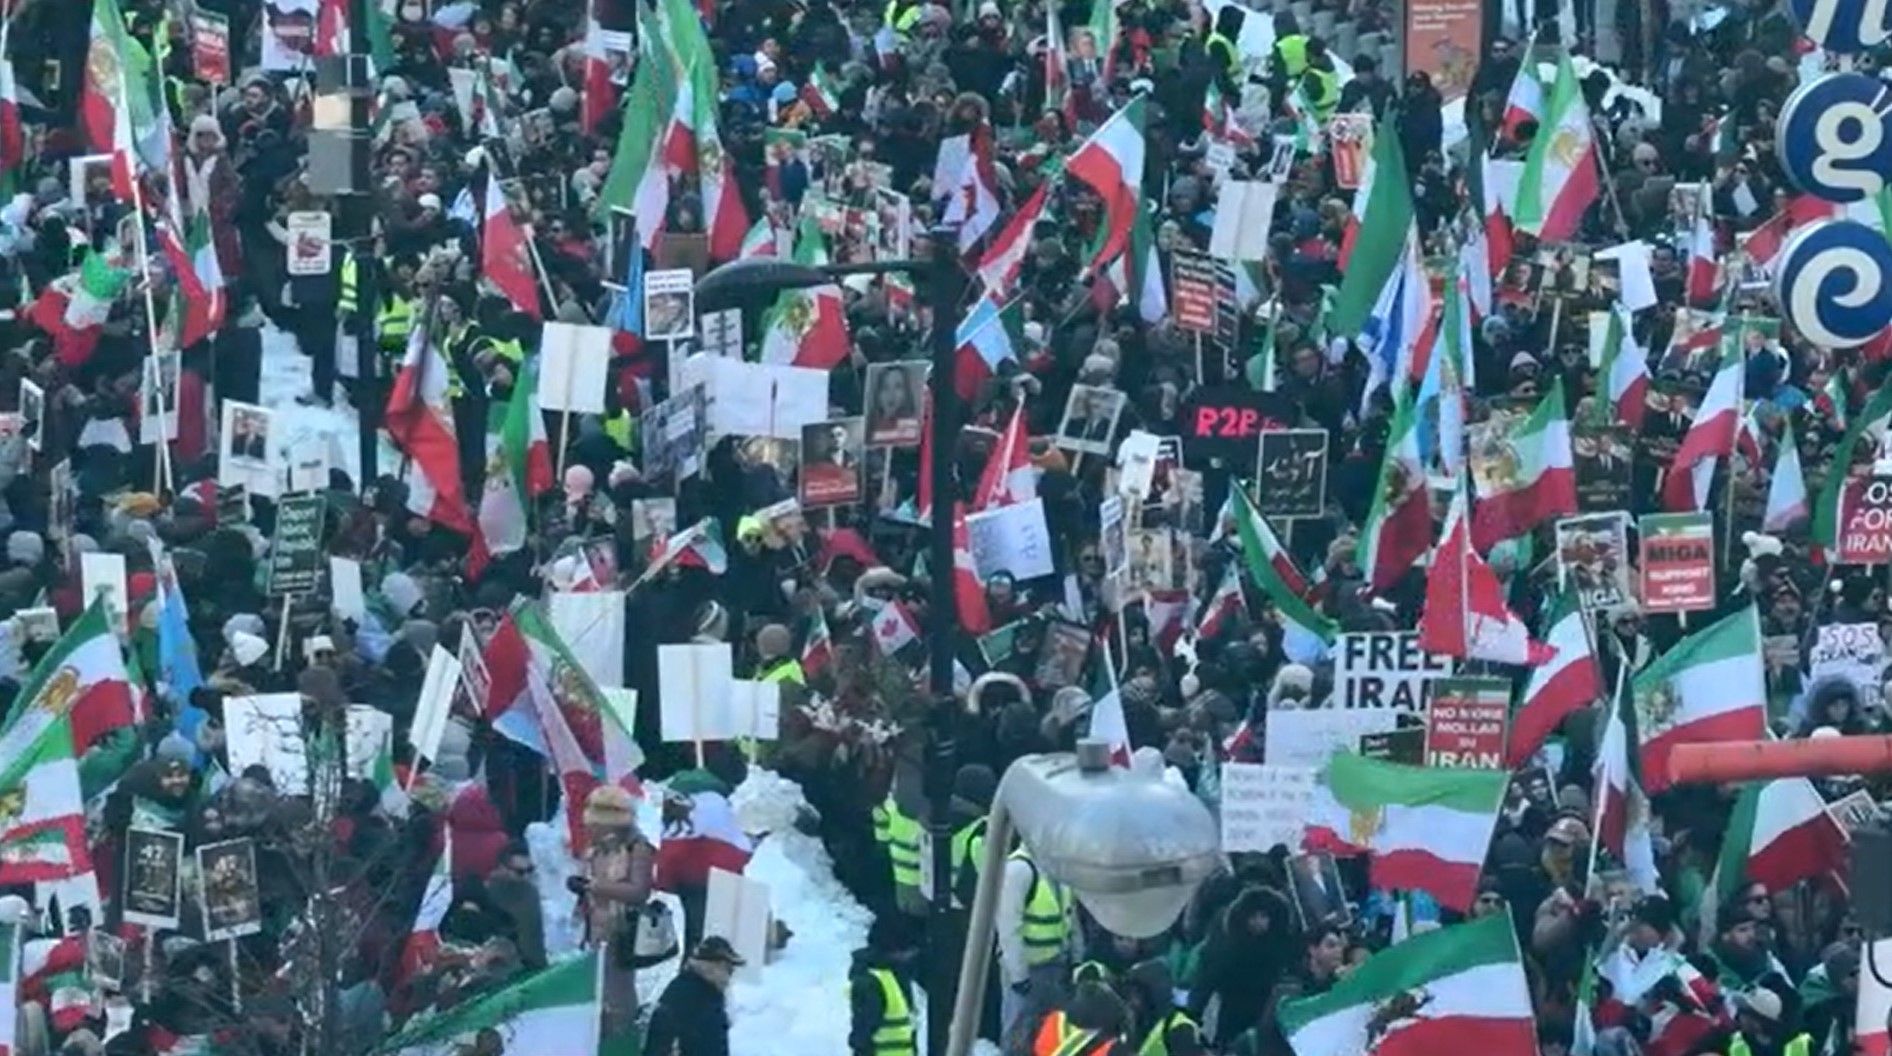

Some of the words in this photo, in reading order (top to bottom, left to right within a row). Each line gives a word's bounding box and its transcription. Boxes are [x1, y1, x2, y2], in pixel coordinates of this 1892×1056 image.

[1826, 626, 1875, 648] SOS
[1433, 708, 1456, 719] NO
[1430, 752, 1500, 769] IRAN
